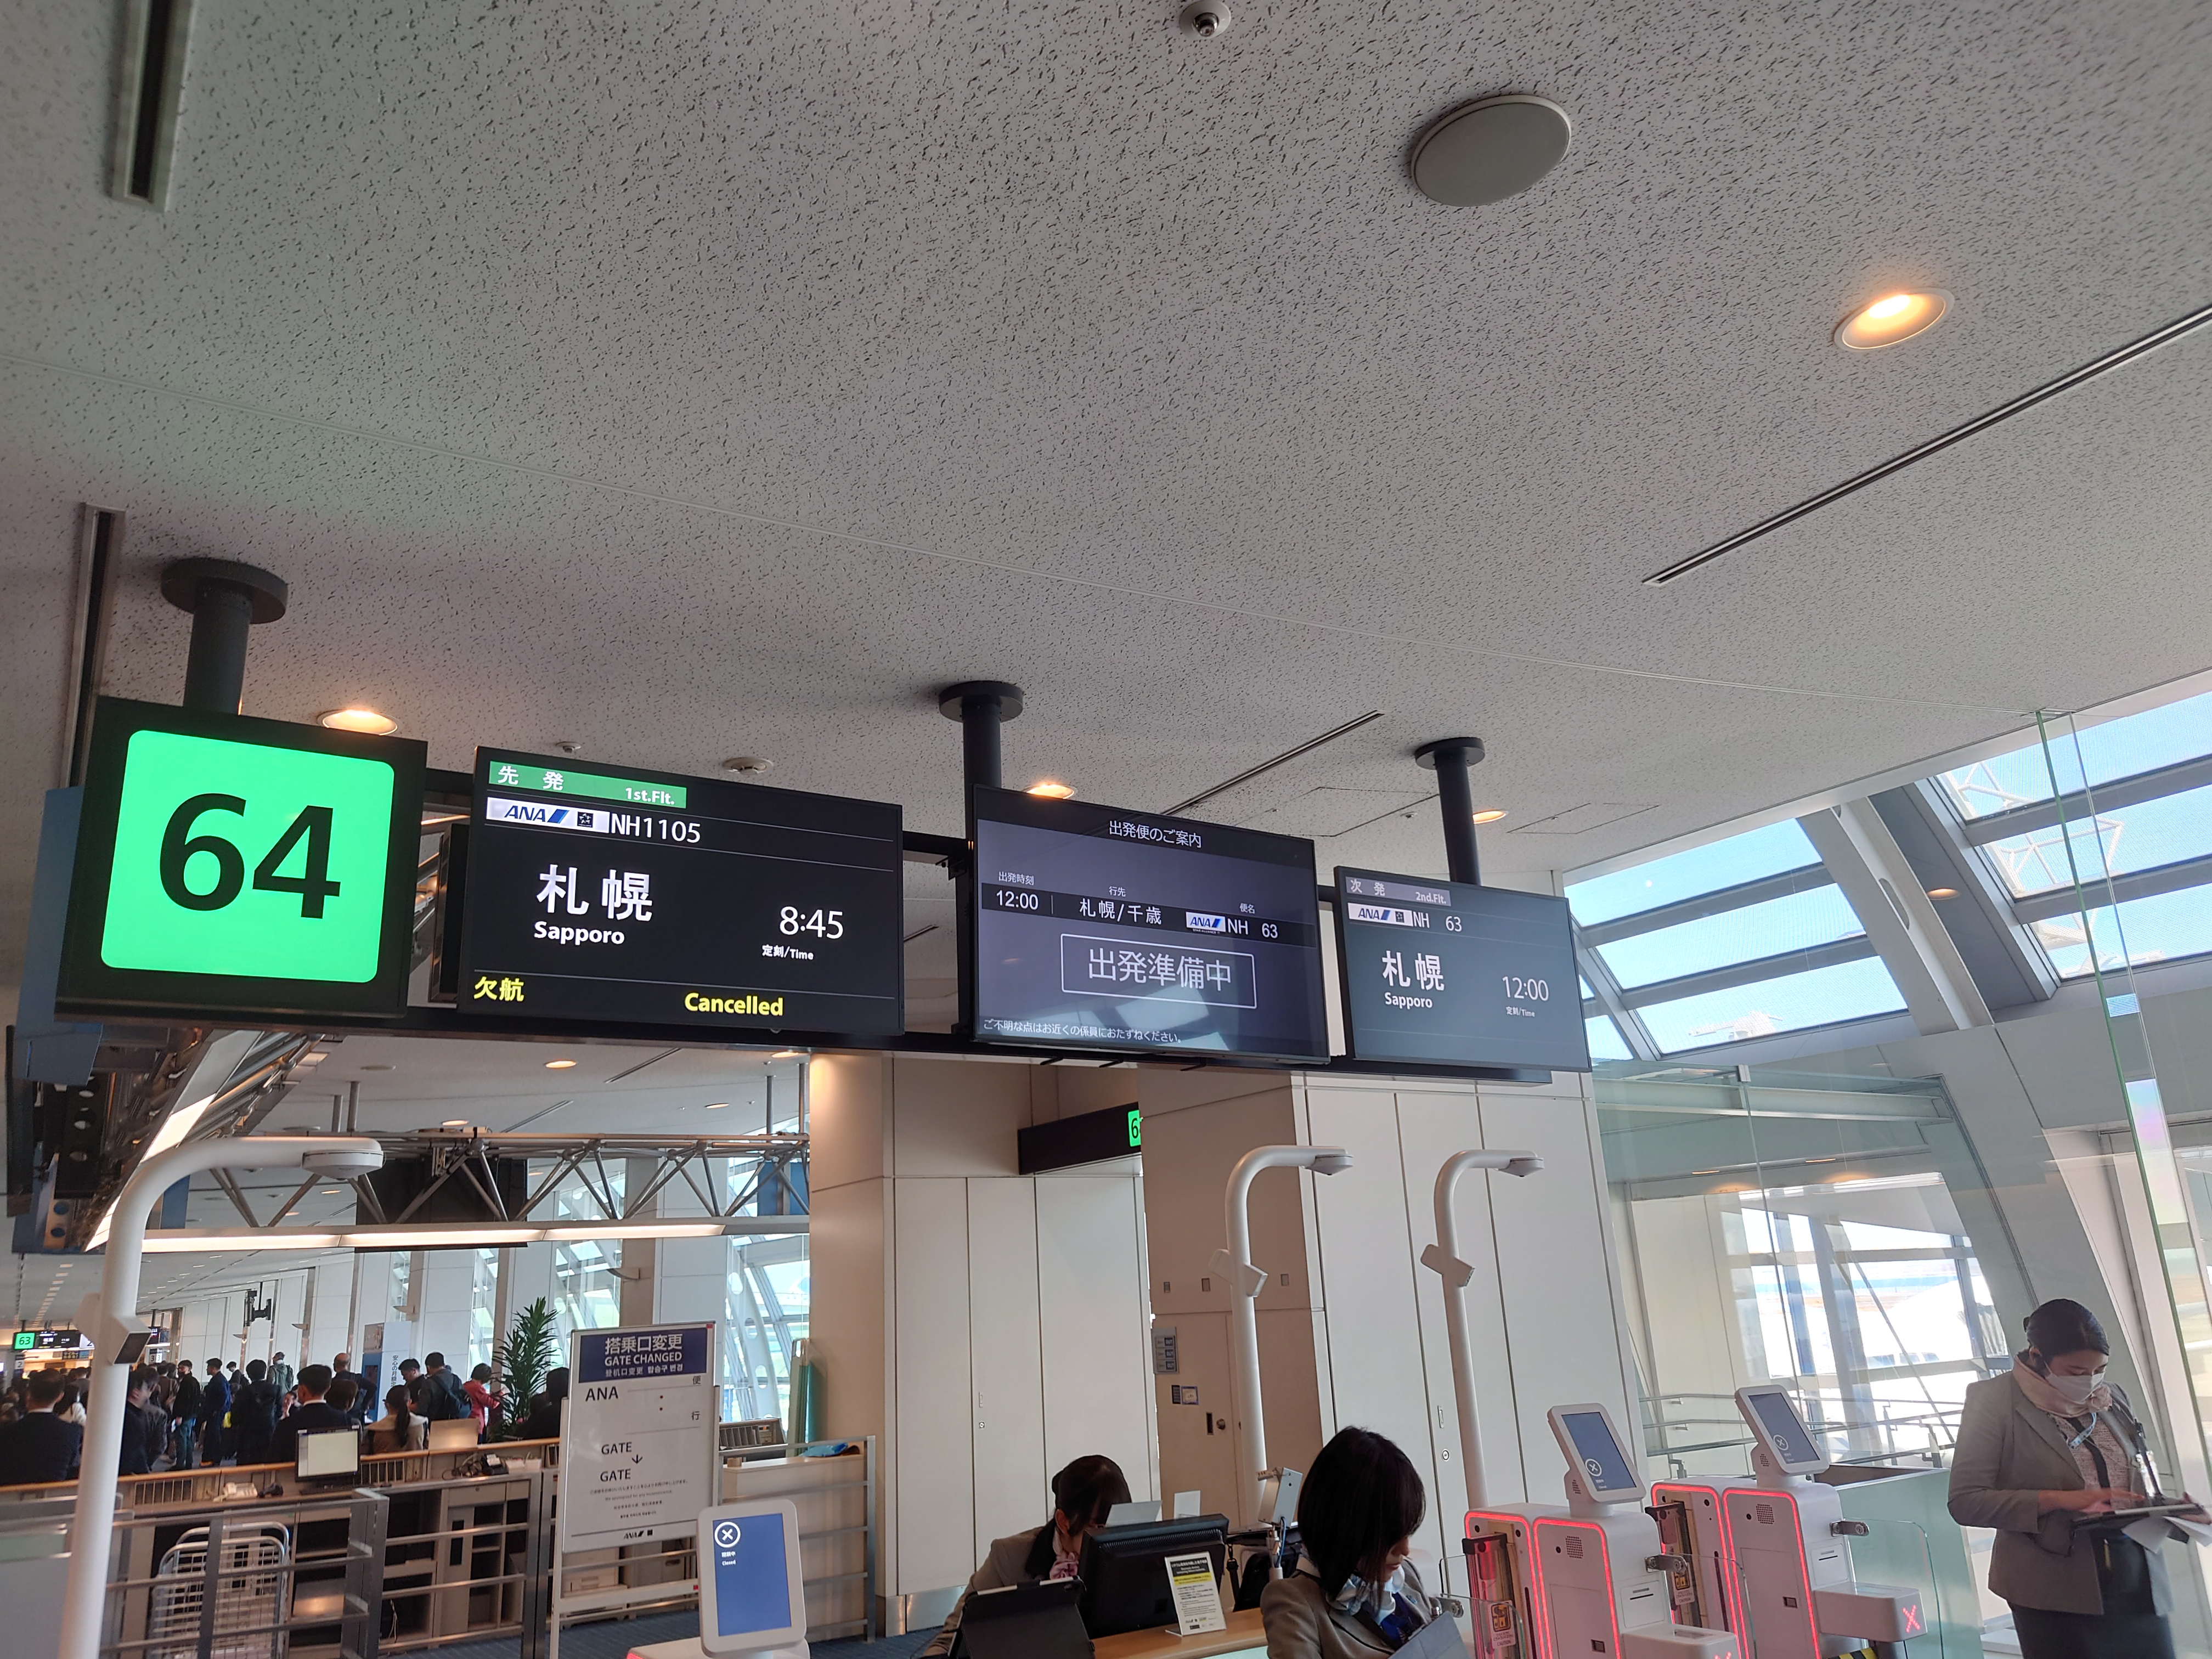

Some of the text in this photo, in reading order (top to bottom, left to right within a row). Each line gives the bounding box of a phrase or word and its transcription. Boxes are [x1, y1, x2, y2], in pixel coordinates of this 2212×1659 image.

[504, 805, 701, 844] ANA NH1105
[1109, 820, 1201, 849] 出発便のご案内
[159, 793, 341, 919] 64
[998, 871, 1035, 886] 出発時刻
[535, 864, 653, 923] 札幌
[1108, 885, 1126, 898] 行先
[996, 890, 1039, 911] 12:00
[1190, 917, 1211, 927] ANA
[1227, 918, 1249, 935] NH
[1261, 923, 1278, 939] 63
[1239, 902, 1256, 915] 便名
[779, 906, 844, 940] 8:45
[1358, 908, 1463, 932] ANA NH 63
[533, 920, 625, 946] Sapporo
[1088, 947, 1232, 992] 出発準備中
[1381, 950, 1445, 992] 札幌
[473, 976, 524, 1003] 欠航
[1502, 975, 1549, 1002] 12:00
[684, 992, 783, 1017] Cancelled
[1384, 992, 1434, 1010] Sapporo
[983, 1019, 1182, 1043] ご不明な点はお近くの係員におたずねください。
[1131, 1118, 1141, 1139] 6
[19, 1336, 31, 1345] 63
[605, 1334, 682, 1355] 搭乗口変更
[605, 1352, 682, 1367] GATE CHANGED
[692, 1375, 701, 1385] 便
[585, 1386, 618, 1402] ANA
[691, 1412, 701, 1421] 行
[601, 1442, 632, 1455] GATE
[600, 1469, 631, 1482] GATE
[624, 1531, 637, 1539] ANA
